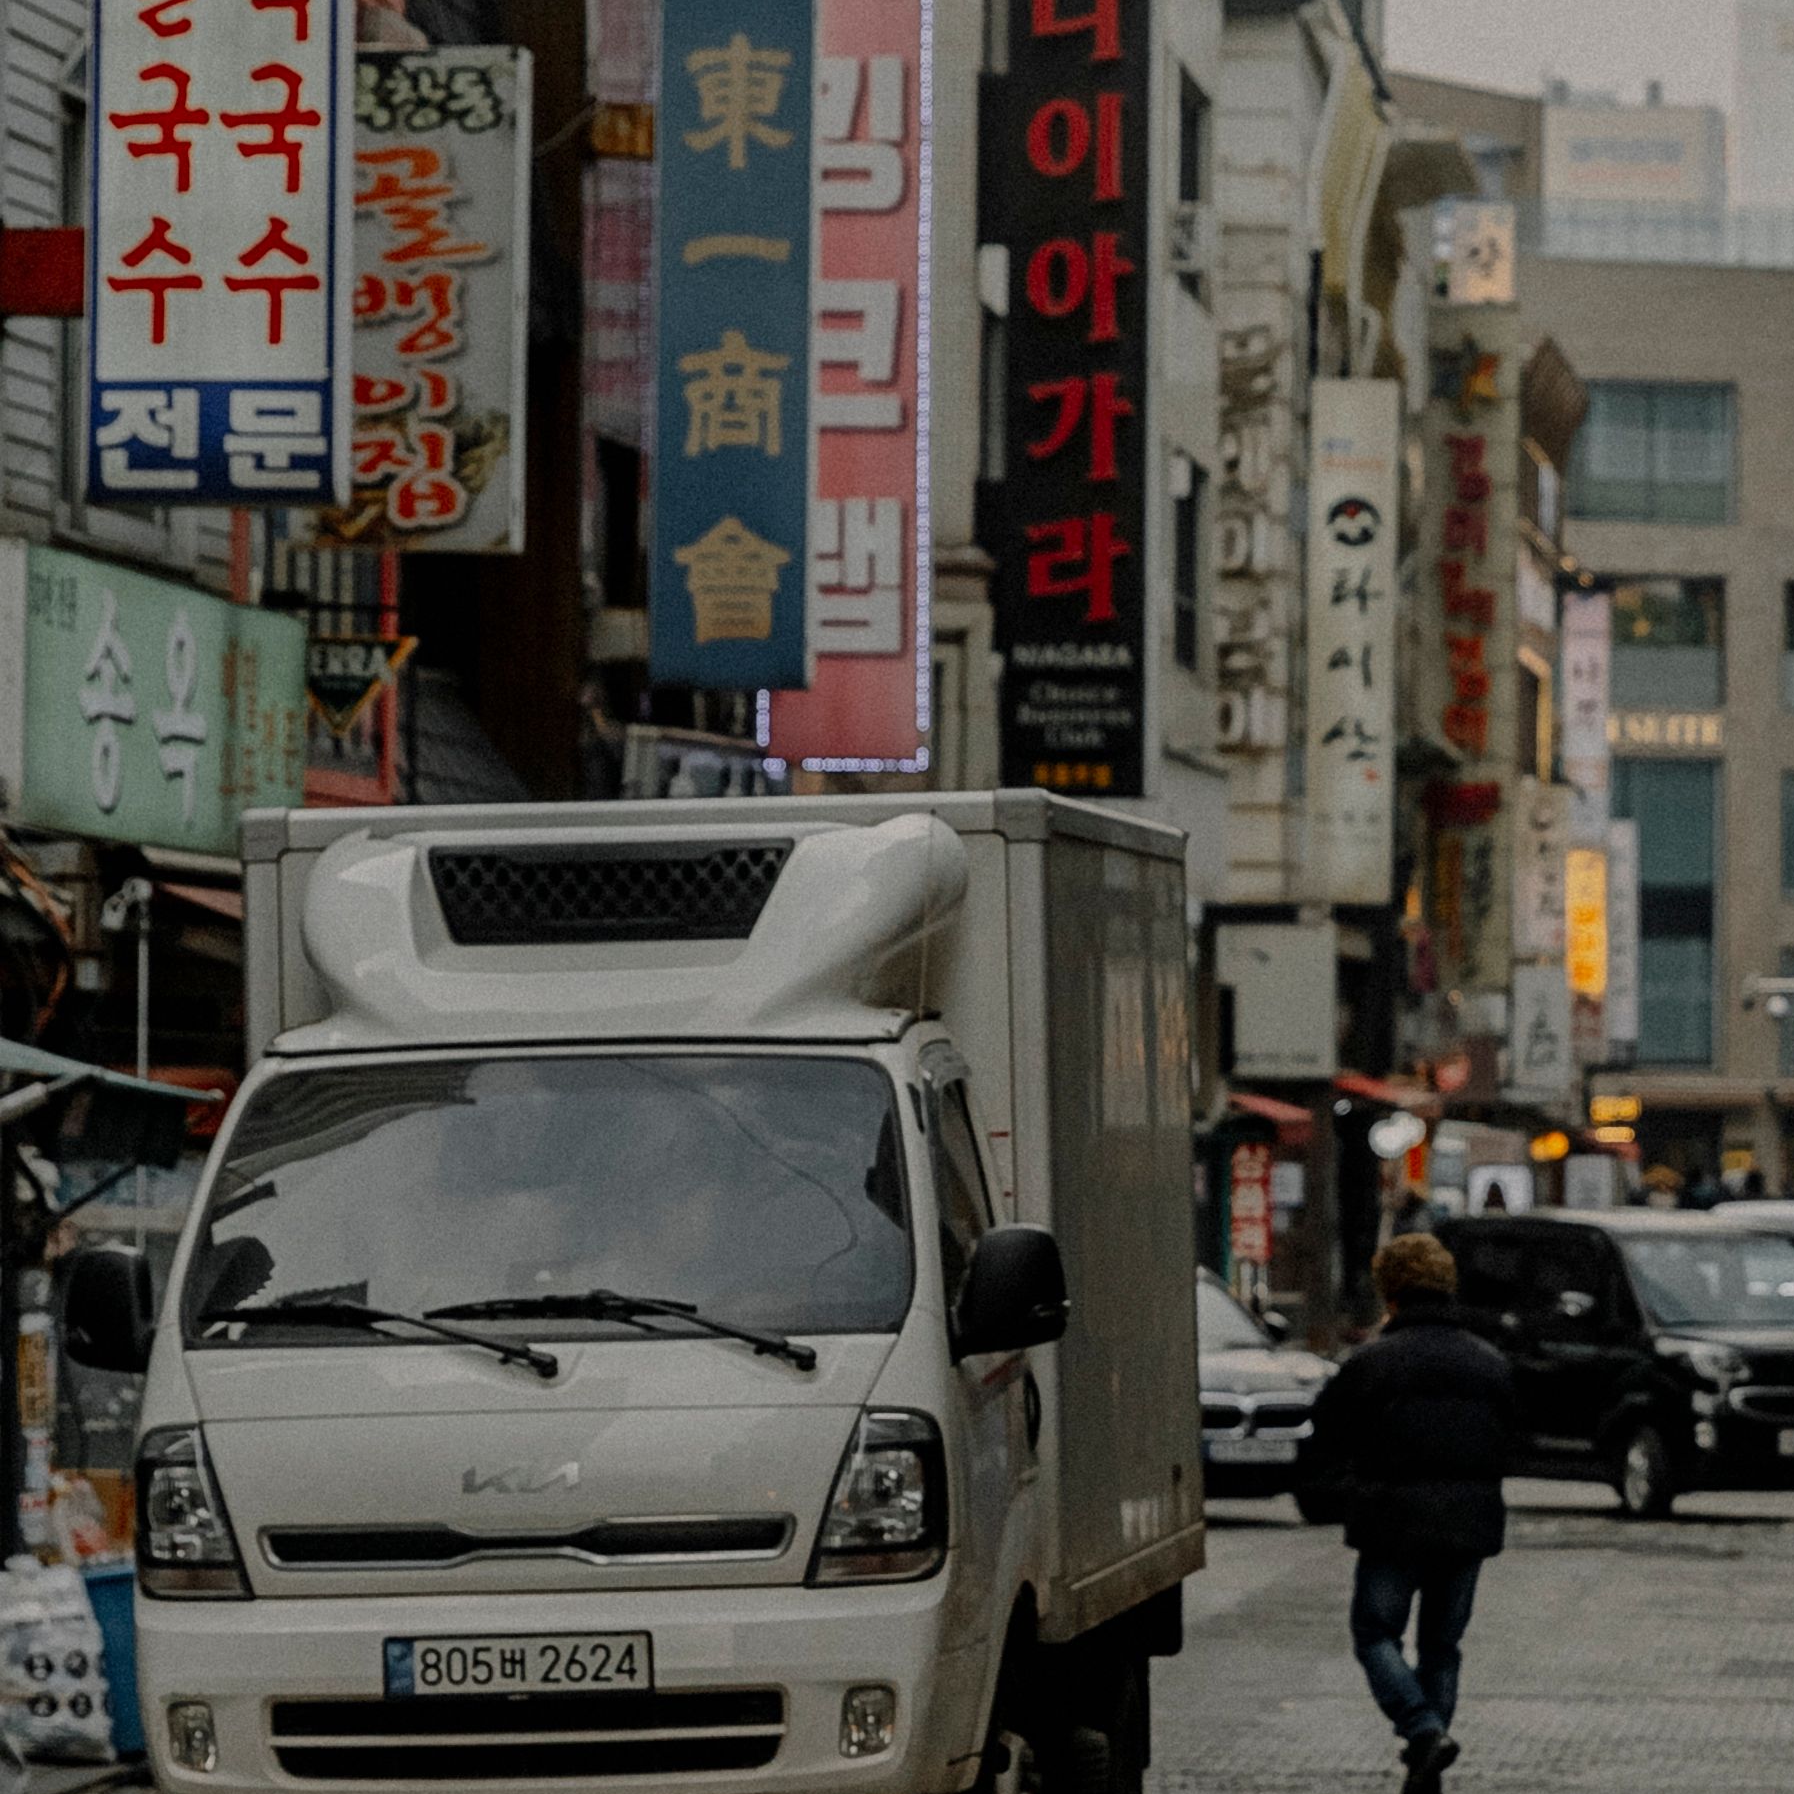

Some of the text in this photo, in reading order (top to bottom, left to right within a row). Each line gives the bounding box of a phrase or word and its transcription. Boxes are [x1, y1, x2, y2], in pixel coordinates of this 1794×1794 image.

[674, 32, 792, 645] 東一商會
[95, 387, 330, 493] 전문
[310, 645, 389, 677] ERRA
[79, 588, 207, 823] 송옥
[461, 1460, 581, 1494] KIA
[419, 1642, 639, 1687] 805버 2624
